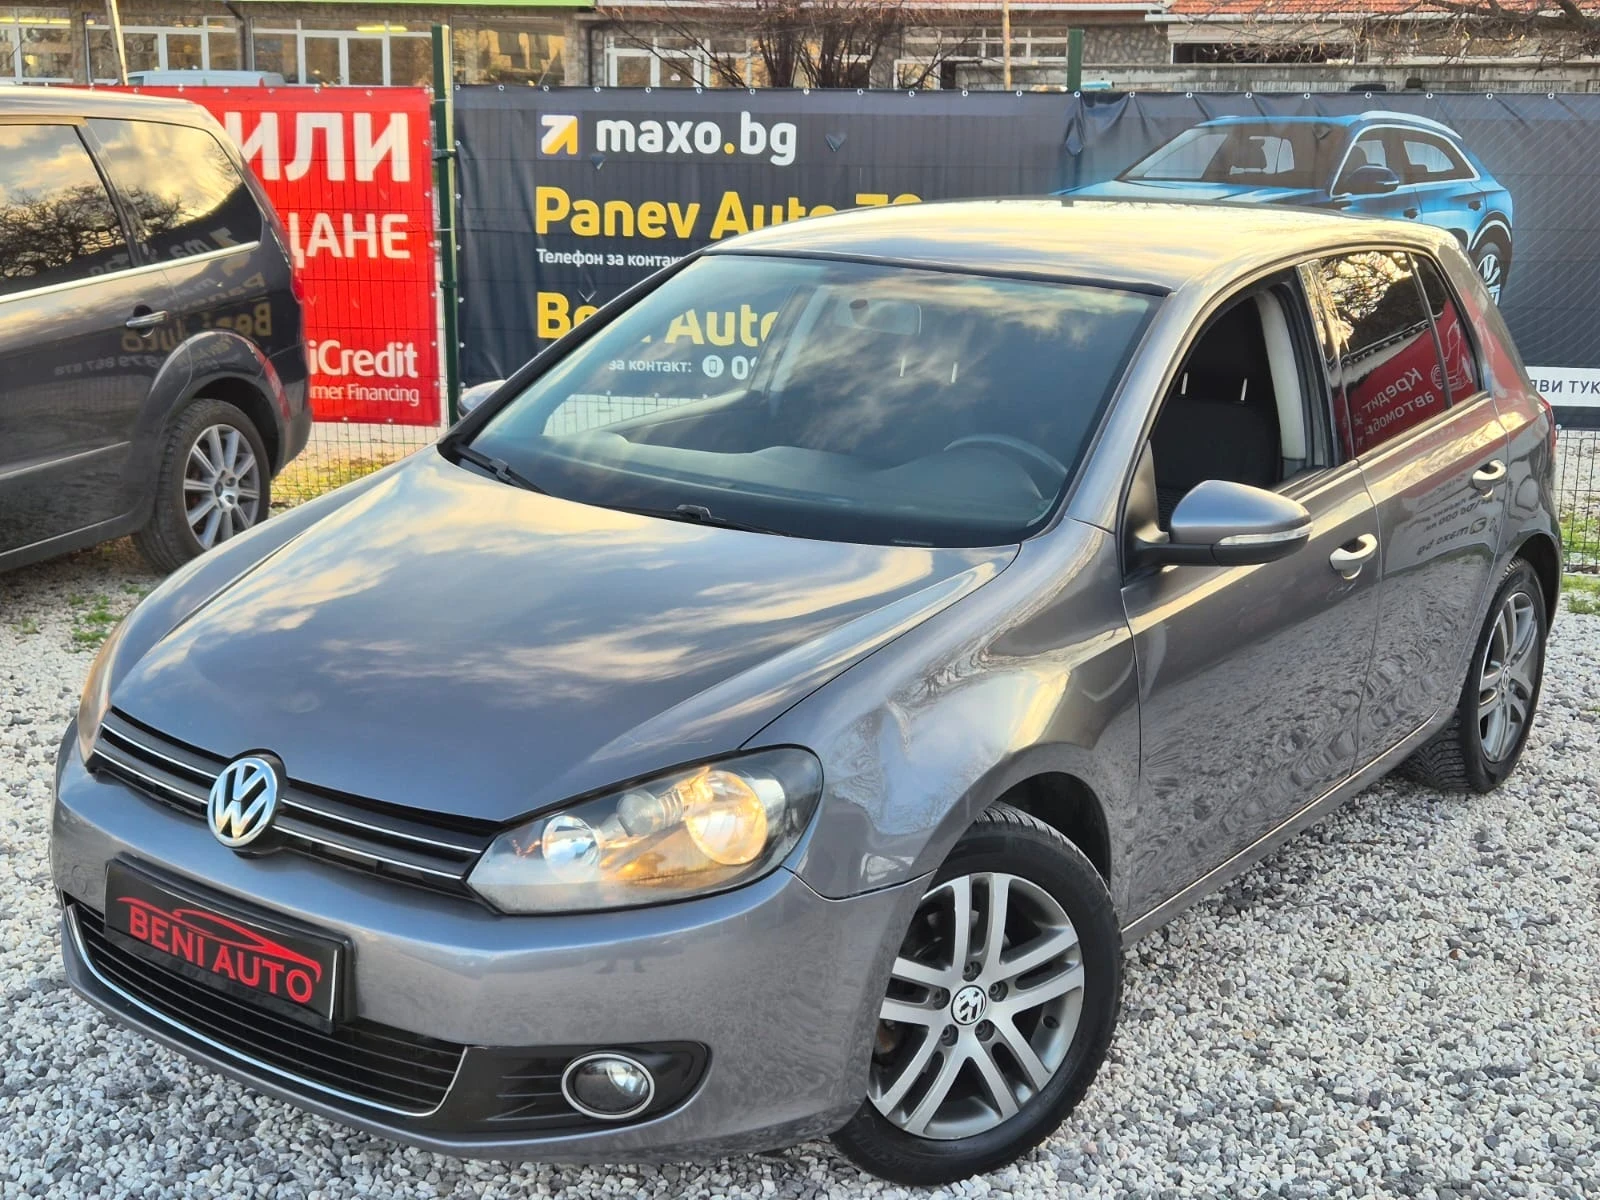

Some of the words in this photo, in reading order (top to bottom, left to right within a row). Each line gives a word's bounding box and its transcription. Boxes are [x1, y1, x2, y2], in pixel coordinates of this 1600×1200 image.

[596, 111, 797, 166] maxo.bg
[536, 186, 700, 238] Panev
[536, 249, 603, 267] Телефон
[607, 254, 624, 266] за
[347, 383, 419, 406] Financing
[129, 903, 204, 967] BENI
[212, 944, 312, 1004] AUTO
